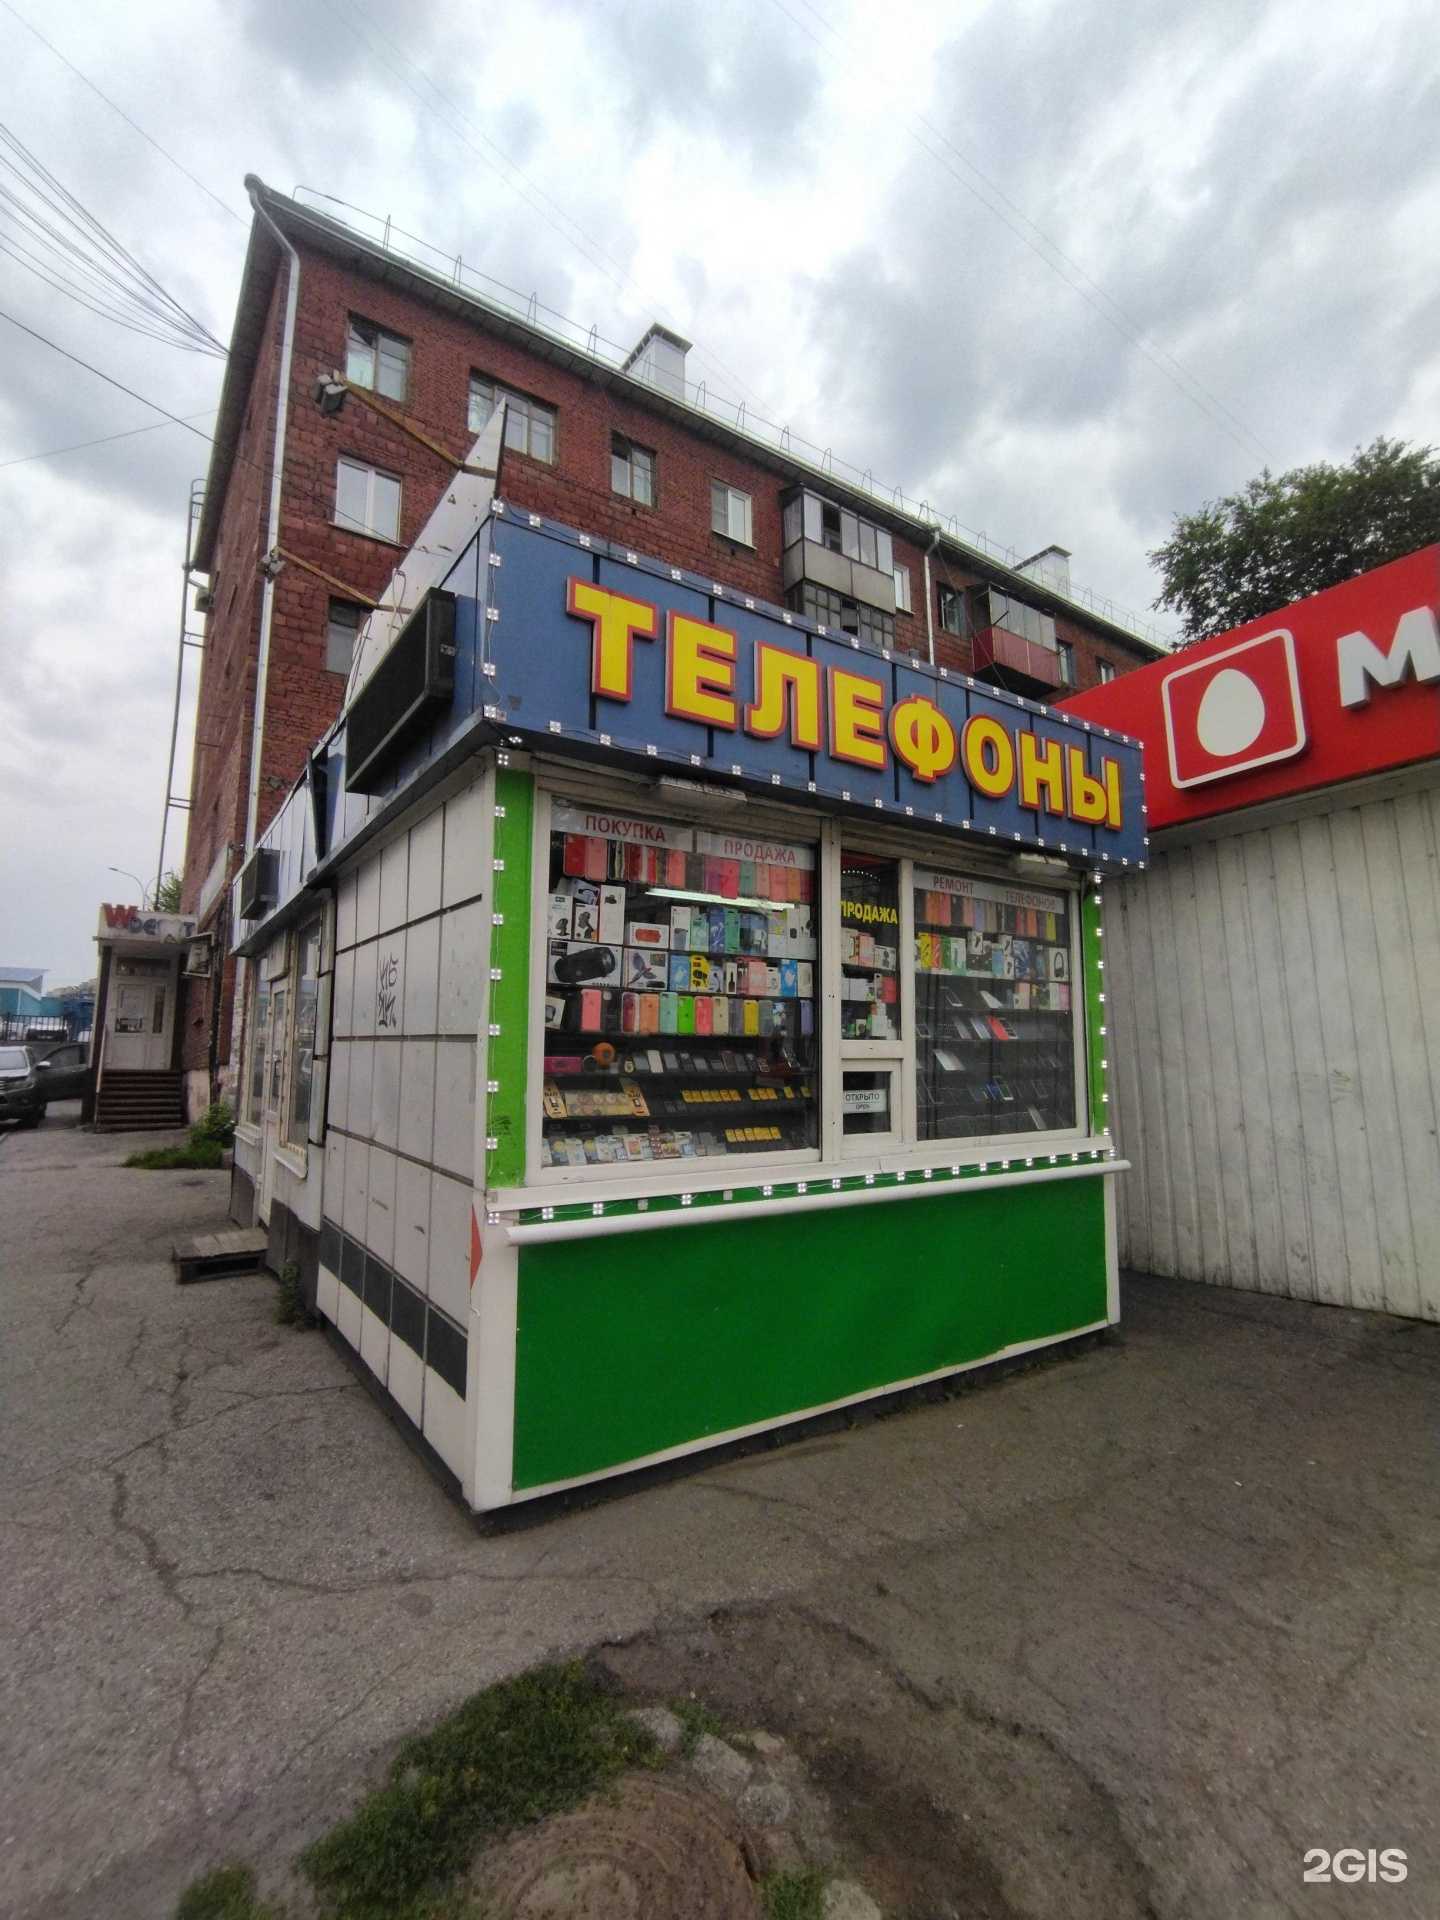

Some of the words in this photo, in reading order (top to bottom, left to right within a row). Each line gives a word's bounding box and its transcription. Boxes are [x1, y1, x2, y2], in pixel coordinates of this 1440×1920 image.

[567, 575, 1122, 831] ТЕЛЕФОНЫ
[585, 815, 666, 842] ПОКУПКА
[724, 839, 796, 865] ПРОДАЖА
[933, 875, 974, 896] РЕМОНТ
